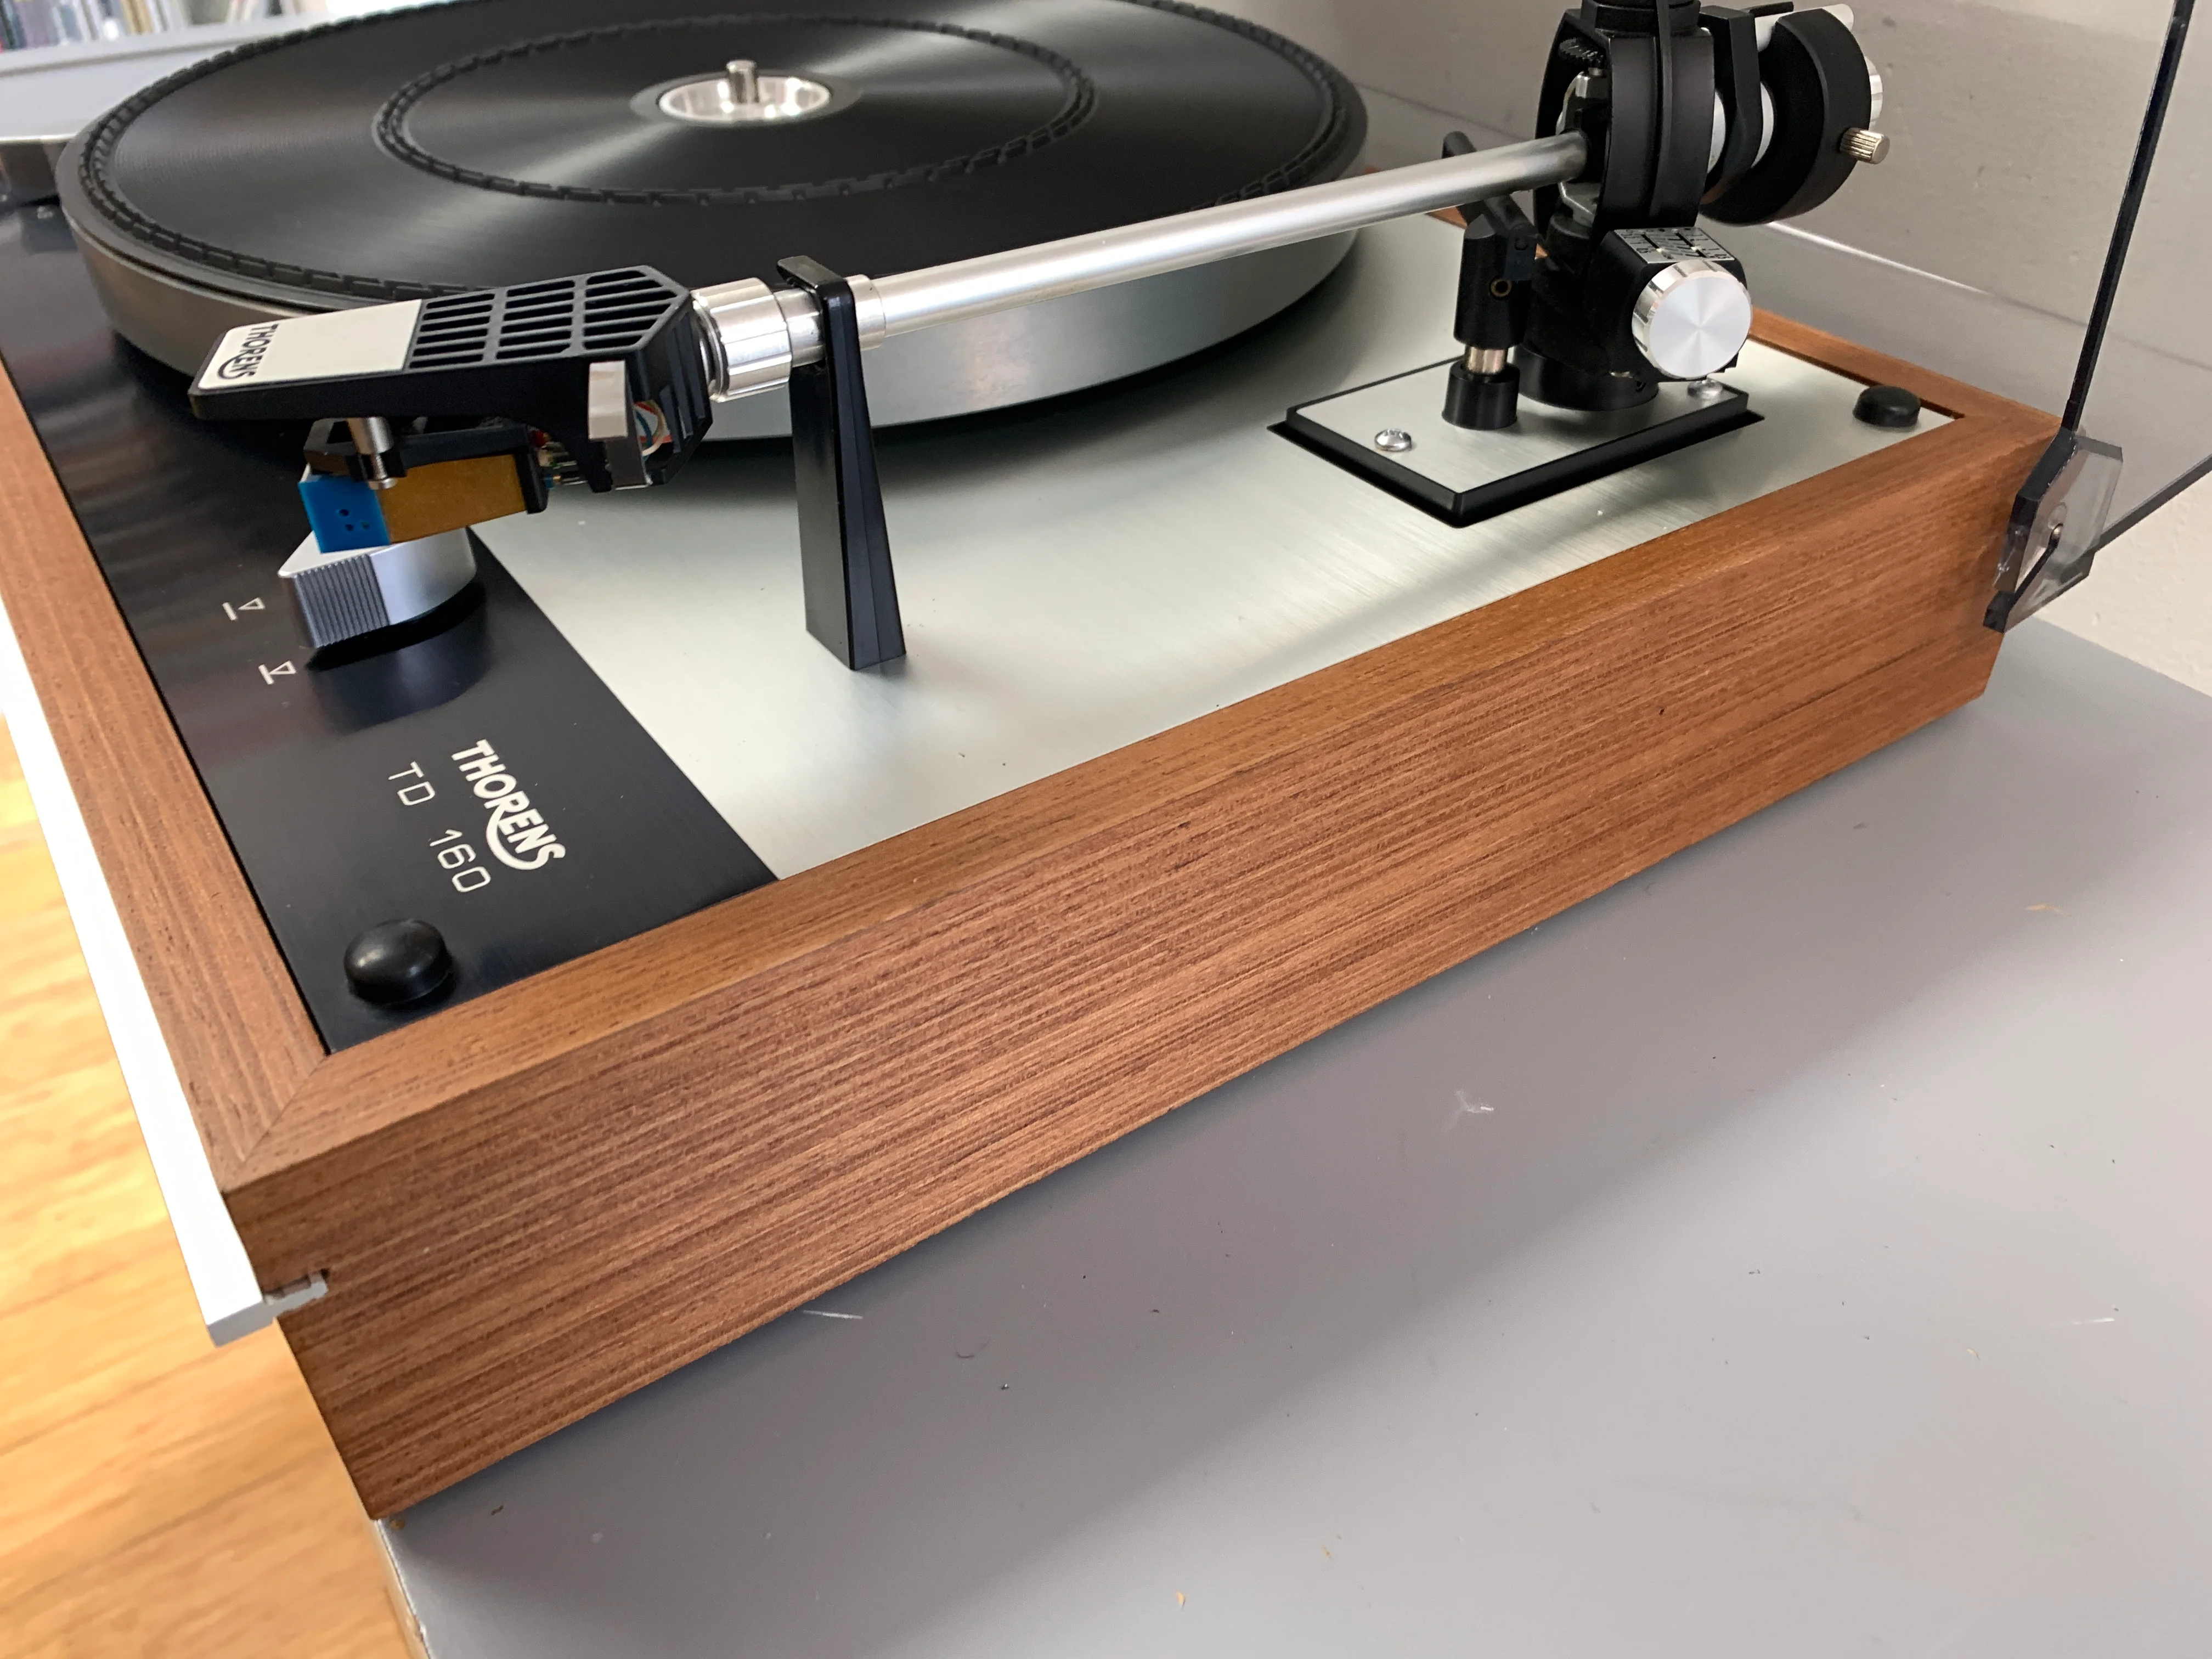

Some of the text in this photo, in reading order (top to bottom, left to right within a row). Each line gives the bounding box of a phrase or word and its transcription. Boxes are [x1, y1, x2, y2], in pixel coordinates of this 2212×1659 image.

[217, 324, 279, 379] THORENS
[388, 761, 491, 893] TD 160
[452, 739, 566, 870] THORENS
